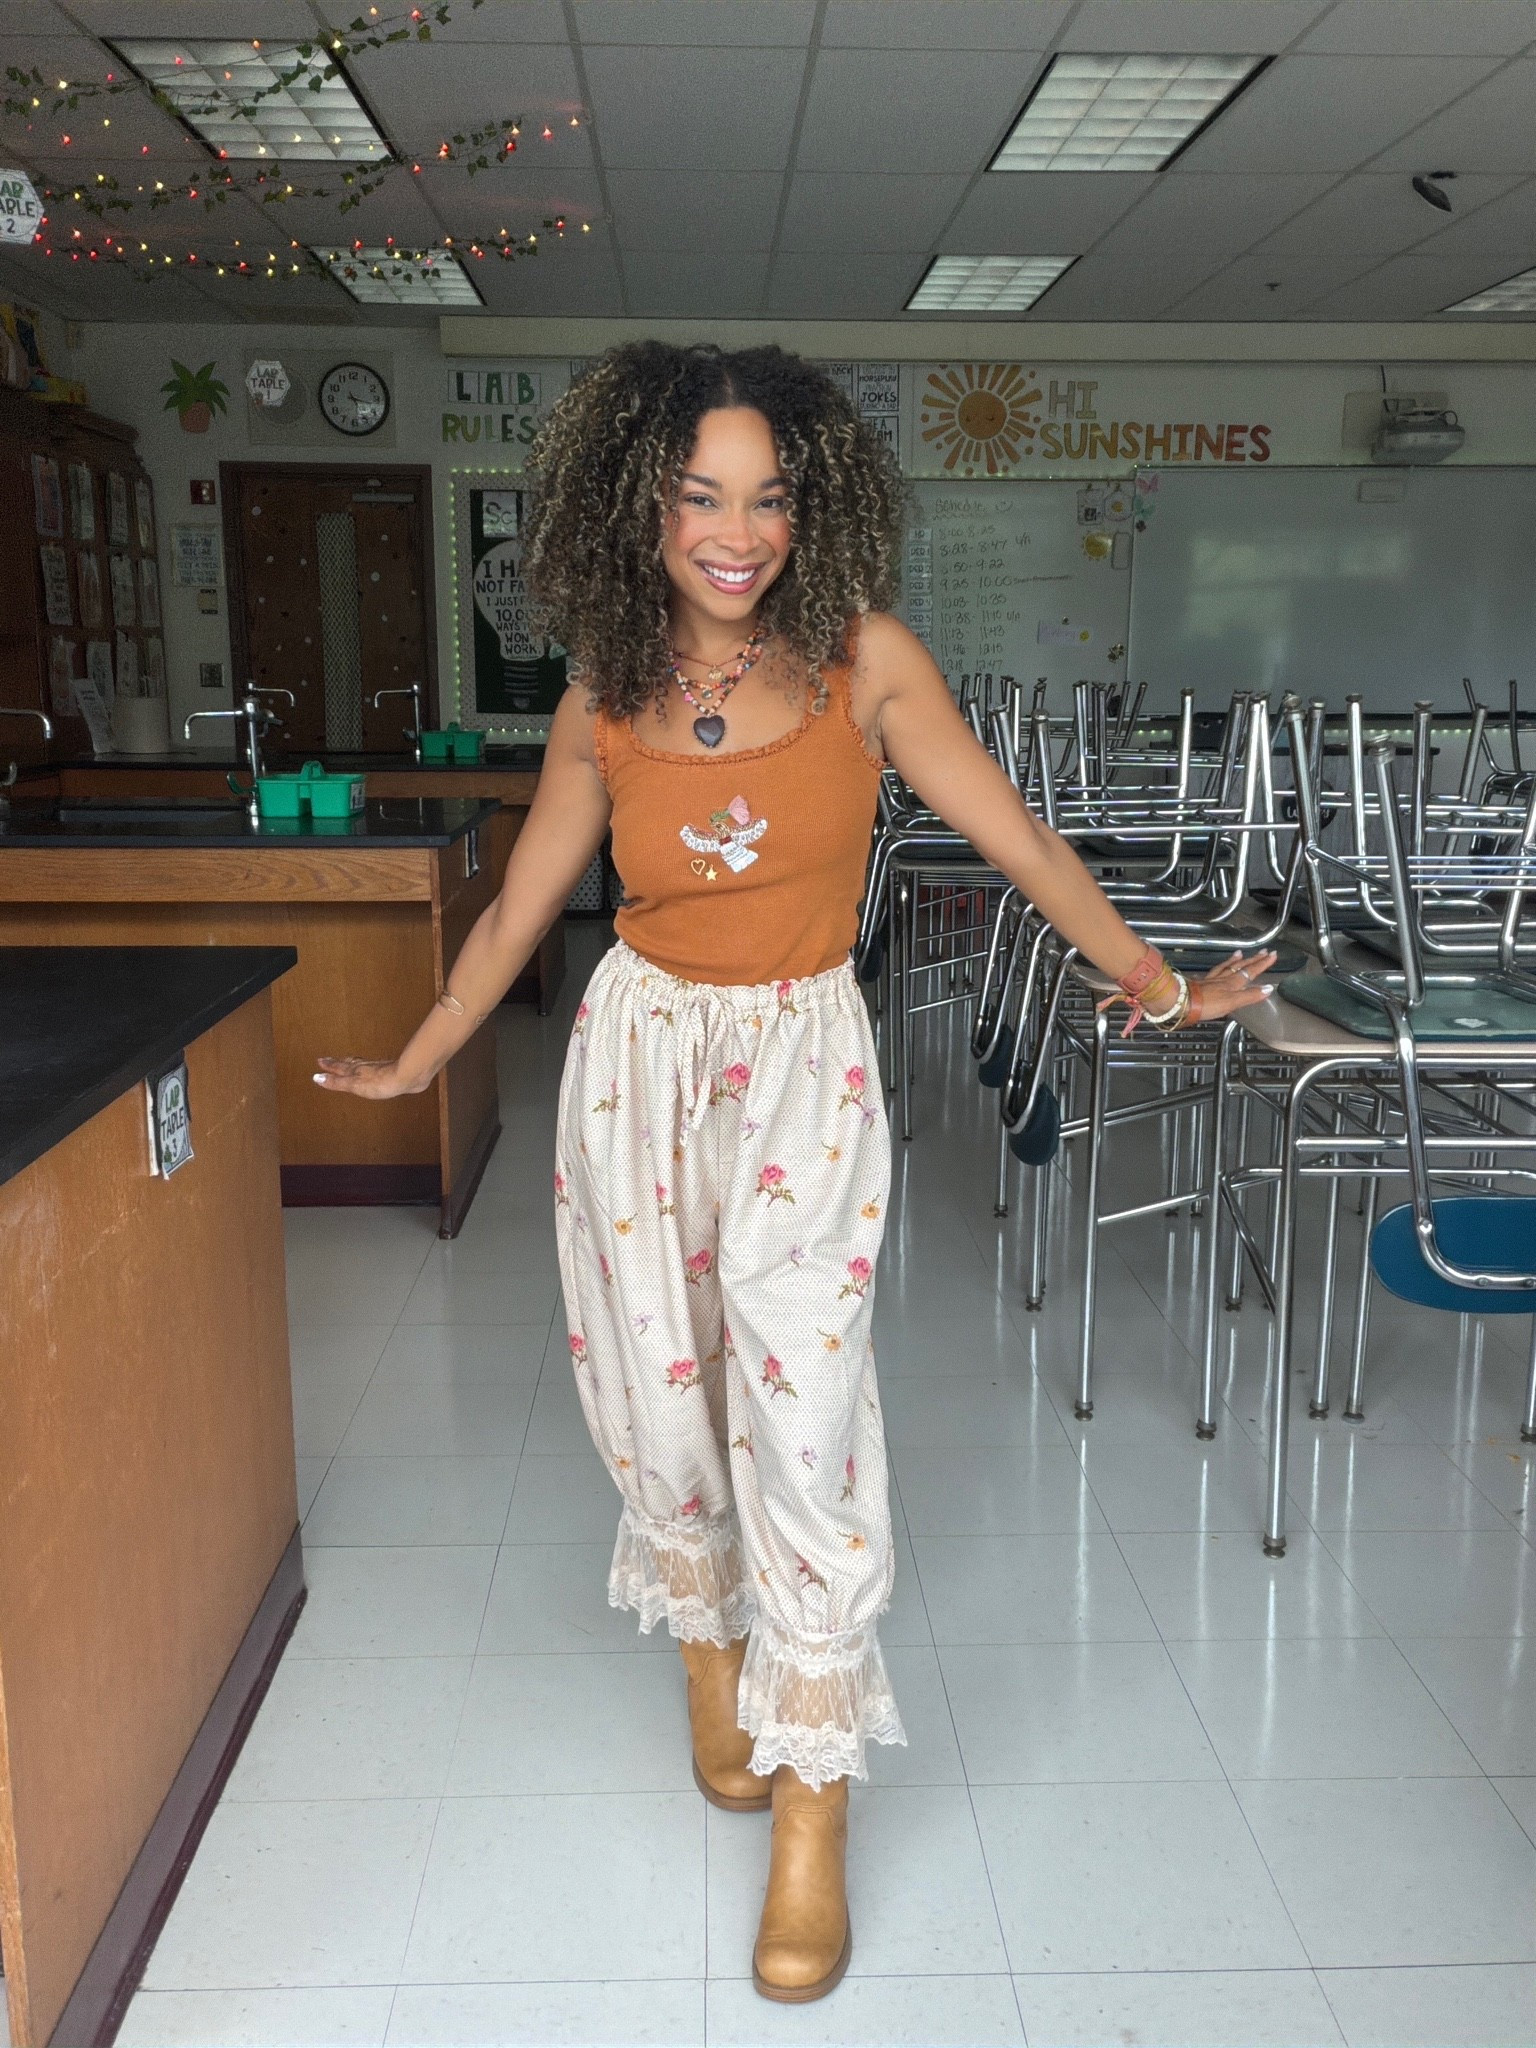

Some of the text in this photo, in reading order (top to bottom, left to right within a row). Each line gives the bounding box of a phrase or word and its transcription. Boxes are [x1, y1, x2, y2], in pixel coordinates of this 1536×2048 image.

[0, 181, 23, 199] AB
[0, 198, 35, 217] ABLE
[6, 218, 16, 234] 2
[251, 377, 286, 391] TABLE
[349, 371, 359, 380] 12
[330, 384, 340, 392] 10
[456, 372, 535, 405] LAB
[860, 392, 897, 403] JOKES
[1049, 380, 1099, 419] HI
[442, 413, 537, 445] RULES
[1040, 421, 1272, 462] SUNSHINES
[485, 501, 513, 525] Sc
[483, 559, 491, 578] I
[476, 580, 505, 593] NOT
[486, 596, 491, 606] I
[495, 596, 518, 606] JUST
[496, 622, 520, 632] WAYS
[505, 632, 529, 643] WON
[165, 1084, 180, 1114] LAB
[161, 1106, 185, 1141] TABLE
[172, 1138, 178, 1159] 3
